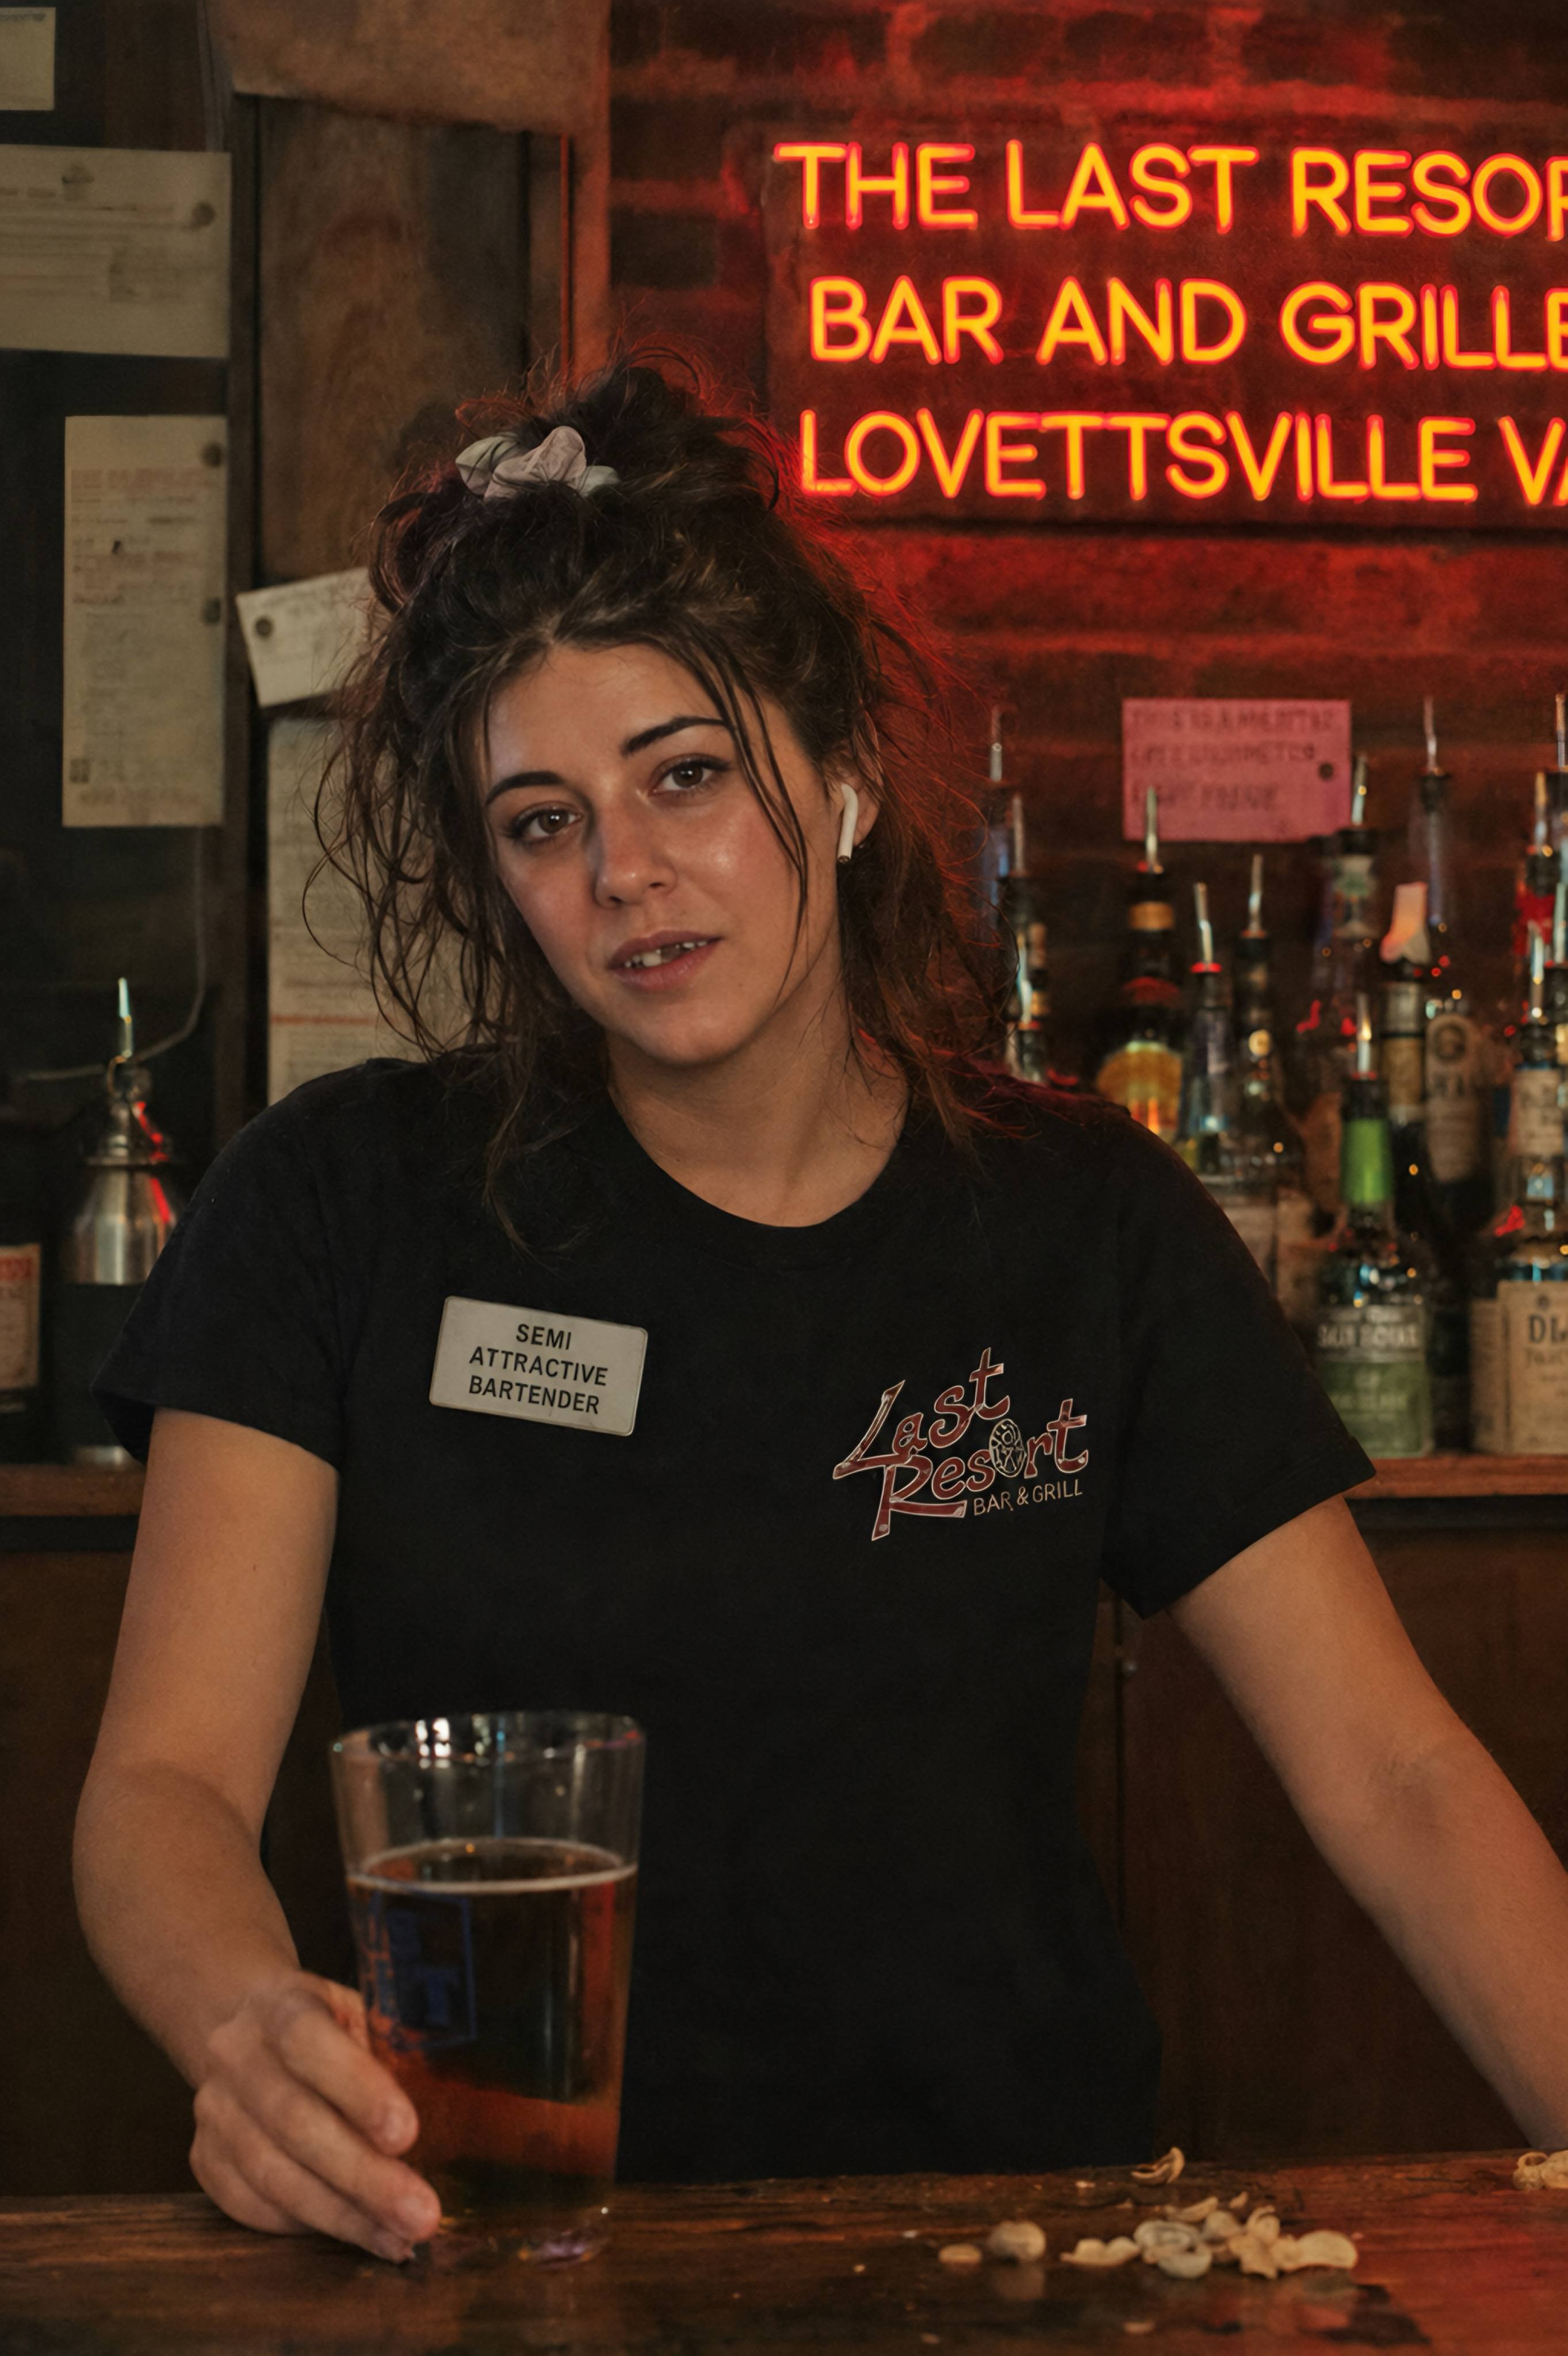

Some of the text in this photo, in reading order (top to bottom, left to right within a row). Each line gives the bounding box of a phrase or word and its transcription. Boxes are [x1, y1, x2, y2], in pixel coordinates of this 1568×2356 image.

[774, 141, 978, 230] THE
[1006, 139, 1260, 235] LAST
[810, 274, 1004, 366] BAR
[1035, 276, 1248, 366] AND
[800, 406, 1568, 505] LOVETTSVILLE V
[469, 1346, 608, 1386] ATTRACTIVE
[516, 1324, 571, 1351] SEMI
[469, 1375, 599, 1414] BARTENDER
[832, 1347, 1011, 1480] Last
[973, 1479, 1083, 1516] BAR & GRILL
